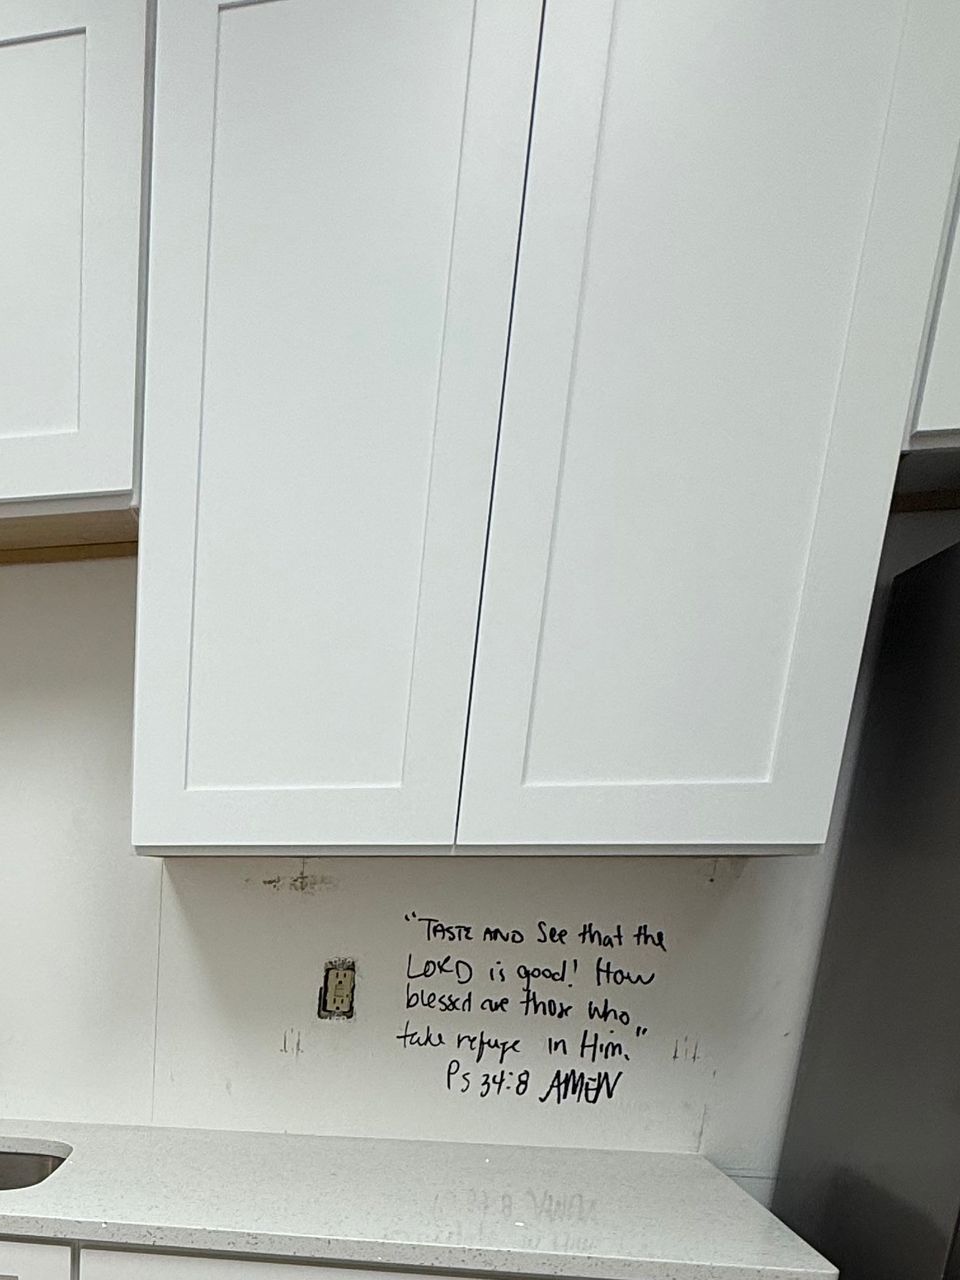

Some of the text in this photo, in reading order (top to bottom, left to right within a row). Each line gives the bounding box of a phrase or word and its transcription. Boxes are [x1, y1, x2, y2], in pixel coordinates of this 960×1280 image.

[483, 925, 525, 944] AND
[537, 921, 567, 945] See
[578, 923, 623, 948] that
[633, 924, 667, 951] the
[407, 954, 655, 992] LORD is good! How
[480, 998, 509, 1012] are
[520, 989, 572, 1019] those
[589, 999, 630, 1025] who
[396, 1020, 445, 1048] take
[457, 1031, 520, 1064] refuge
[548, 1037, 567, 1055] in
[446, 1060, 623, 1104] Ps 34:8 AMEN
